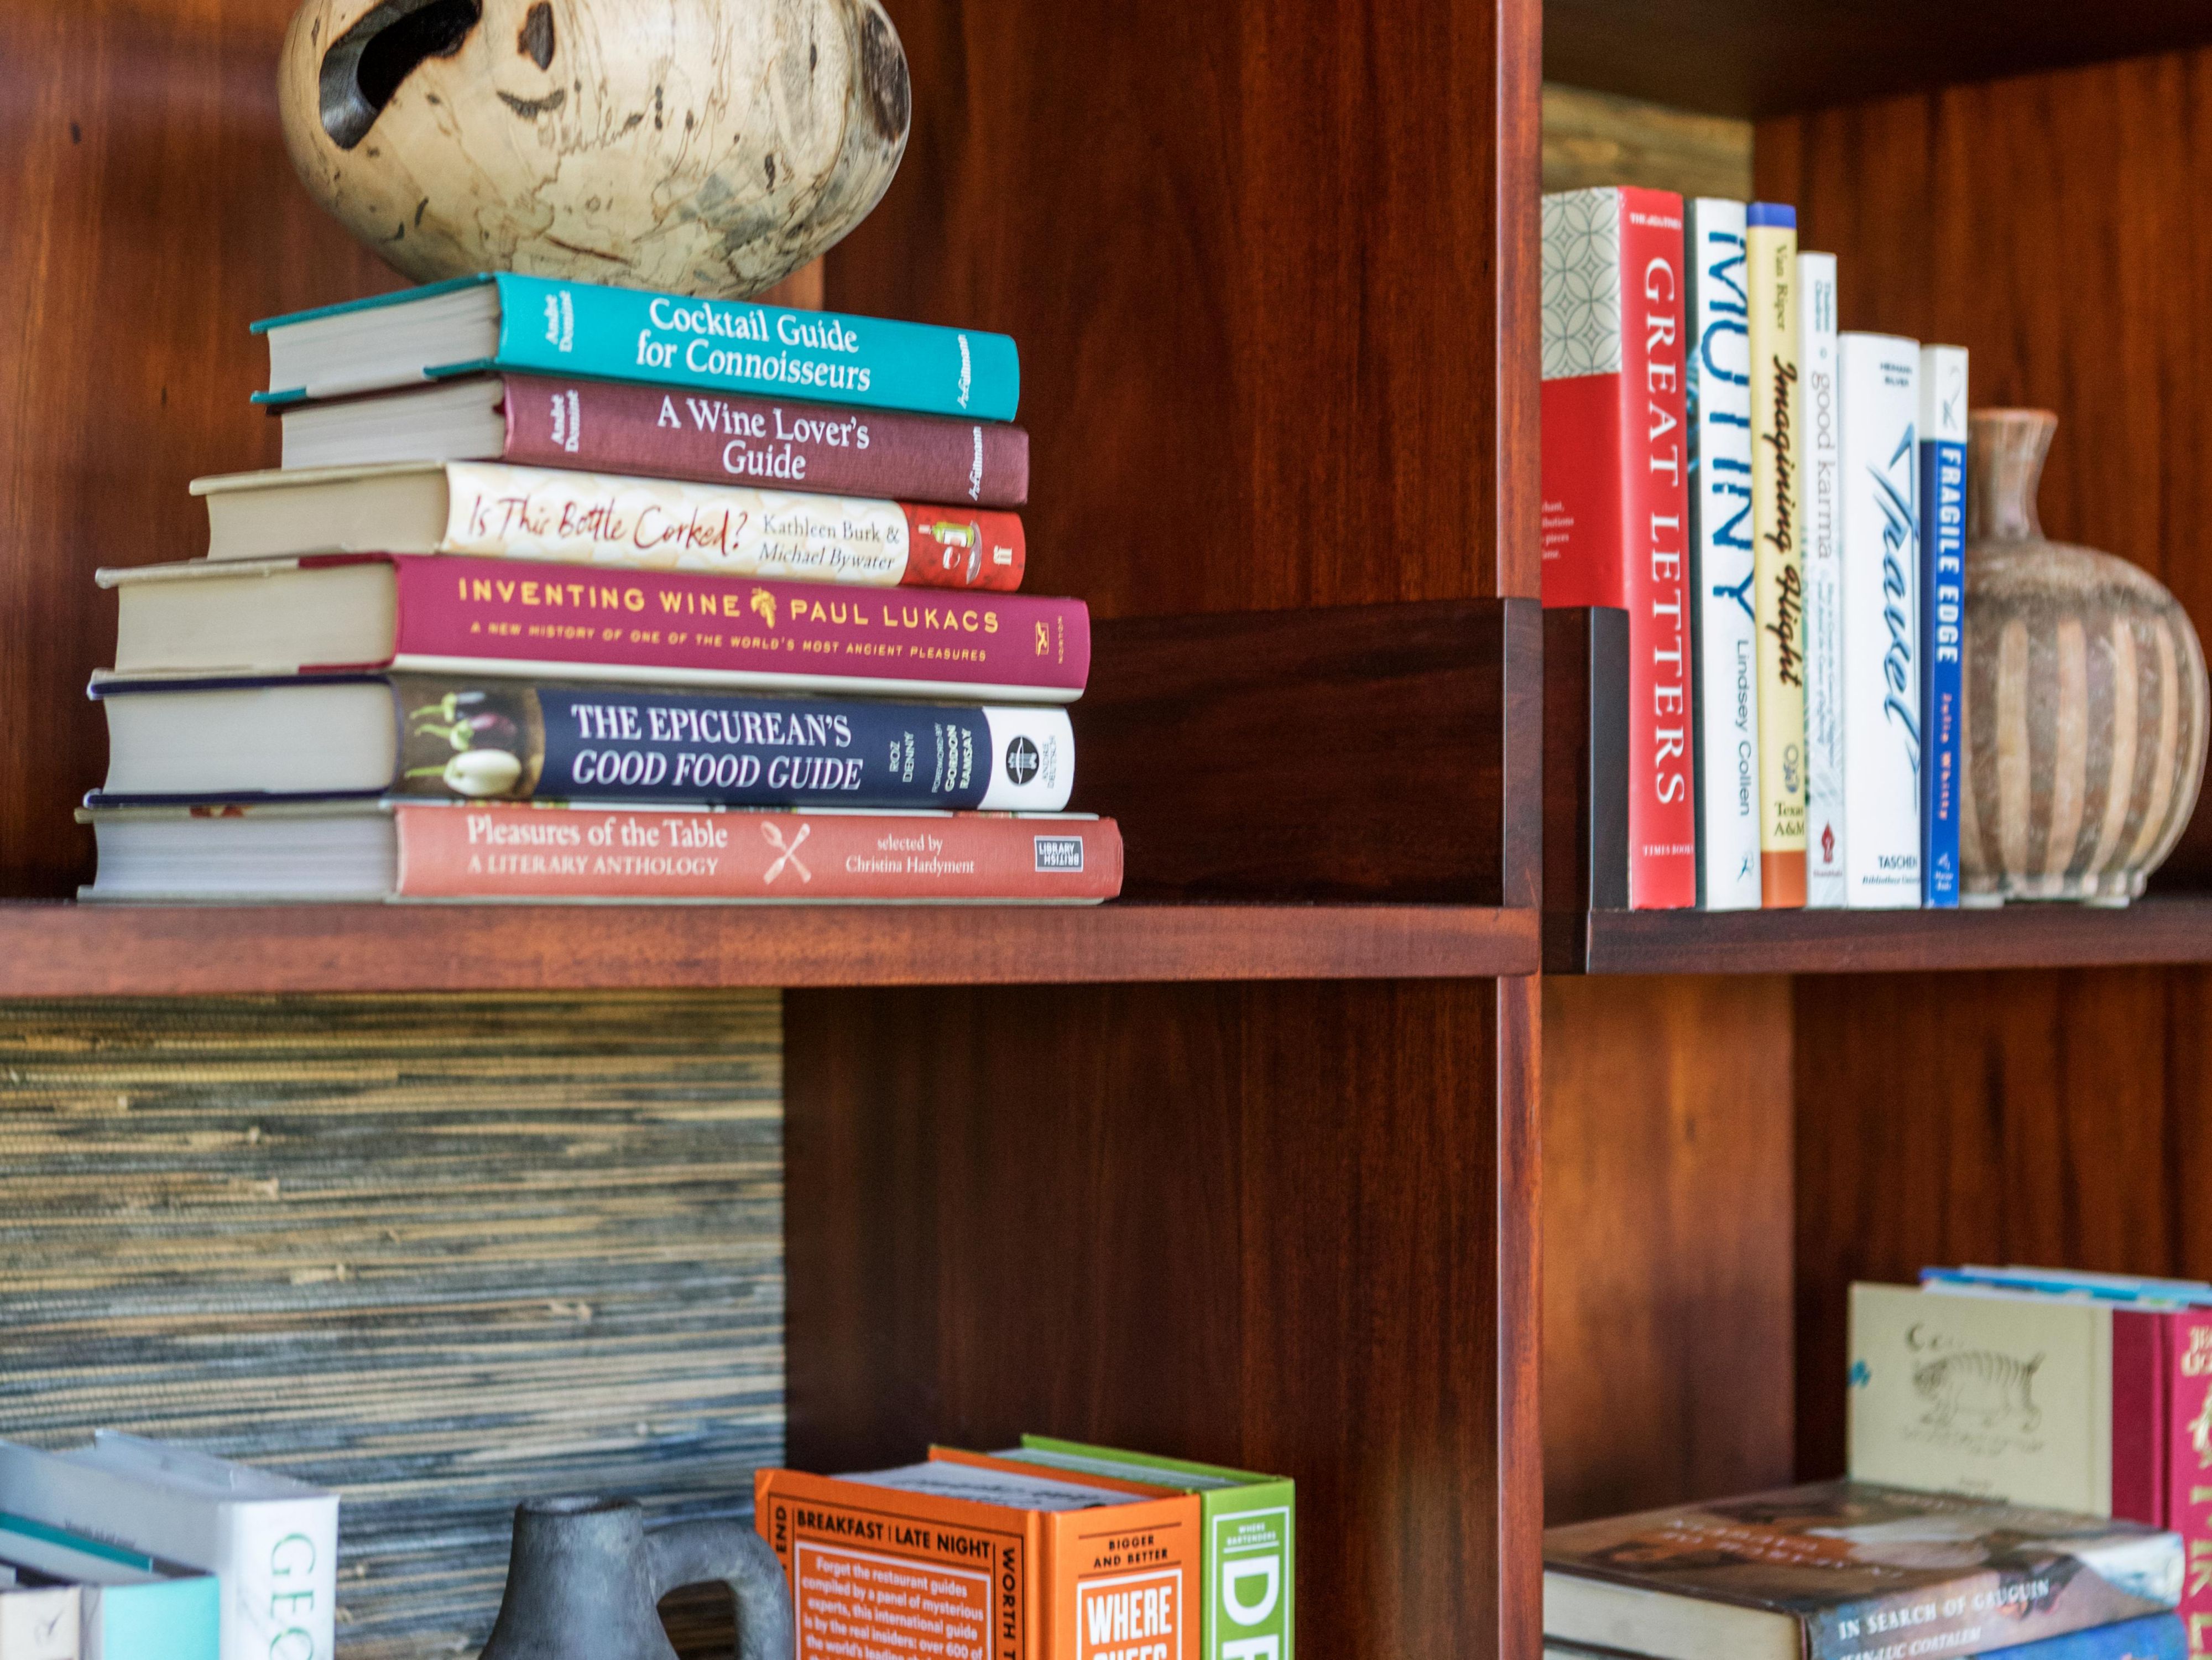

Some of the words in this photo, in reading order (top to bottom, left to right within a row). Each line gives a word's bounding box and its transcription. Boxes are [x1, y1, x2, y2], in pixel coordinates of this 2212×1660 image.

[649, 297, 770, 342] Cocktail
[776, 314, 859, 353] Guide
[636, 328, 678, 368] for
[686, 337, 871, 392] Connoisseurs
[1644, 257, 1679, 487] GREAT
[658, 394, 682, 429] A
[686, 398, 766, 438] Wine
[1701, 231, 1755, 624] MUTINY
[1812, 371, 1835, 450] good
[723, 439, 806, 480] Guide
[1762, 356, 1798, 553] Imagining
[468, 495, 490, 537] Is
[499, 494, 551, 540] This
[558, 497, 627, 542] Bottle
[633, 504, 748, 557] Corked?
[763, 515, 837, 538] Kathleen
[842, 520, 881, 543] Burk
[886, 525, 900, 544] &
[1818, 460, 1835, 560] karma
[1938, 447, 1961, 575] FRAGILE
[759, 543, 826, 566] Michael
[831, 550, 895, 574] Bywater
[458, 577, 645, 611] INVENTING
[659, 590, 741, 617] WINE
[790, 599, 869, 625] PAUL
[883, 604, 999, 633] LUKACS
[1766, 565, 1802, 688] Flight
[1866, 422, 1921, 780] Travel
[1937, 584, 1959, 665] EDGE
[470, 621, 481, 633] A
[488, 622, 521, 636] NEW
[528, 624, 596, 641] HISTORY
[602, 627, 623, 642] OF
[629, 629, 661, 644] ONE
[667, 632, 688, 646] OF
[695, 634, 723, 648] THE
[803, 638, 839, 654] MOST
[846, 641, 904, 658] ANCIENT
[910, 645, 987, 663] PLEASURES
[1650, 512, 1685, 805] LETTERS
[1735, 639, 1751, 732] Lindsey
[571, 704, 642, 741] THE
[571, 749, 667, 786] GOOD
[671, 752, 761, 788] FOOD
[768, 756, 864, 791] GUIDE
[889, 740, 900, 773] ROZ
[902, 730, 914, 783] DENNY
[945, 724, 958, 793] GORDON
[959, 727, 973, 789] RAMSAY
[1738, 741, 1752, 816] Collen
[467, 814, 581, 846] Pleasures
[587, 816, 617, 846] of
[620, 817, 660, 847] the
[662, 818, 728, 848] Table
[877, 834, 925, 852] selected
[928, 835, 943, 856] by
[1039, 842, 1075, 855] LIBRARY
[467, 854, 482, 873] A
[488, 854, 589, 875] LITERARY
[593, 856, 719, 876] ANTHOLOGY
[845, 855, 902, 873] Christina
[906, 856, 975, 877] Hardyment
[1044, 852, 1080, 866] BRITISH
[797, 1508, 884, 1542] BREAKFAST
[895, 1524, 931, 1549] LATE
[936, 1533, 990, 1559] NIGHT
[1109, 1534, 1154, 1550] BIGGER
[1238, 1522, 1265, 1533] WHERE
[816, 1555, 852, 1580] Forget
[853, 1563, 870, 1580] the
[873, 1569, 928, 1591] restaurant
[931, 1578, 968, 1598] guides
[1094, 1554, 1121, 1569] AND
[1128, 1548, 1168, 1564] BETTER
[802, 1576, 851, 1597] compiled
[853, 1584, 867, 1601] by
[868, 1591, 875, 1601] a
[877, 1591, 907, 1607] panel
[909, 1594, 922, 1609] of
[922, 1599, 984, 1621] mysterious
[808, 1597, 851, 1617] experts,
[852, 1604, 872, 1620] this
[874, 1609, 943, 1633] international
[945, 1623, 978, 1641] guide
[1003, 1547, 1016, 1640] WORTH
[1087, 1585, 1172, 1646] WHERE
[1839, 1619, 1860, 1640] IN
[1866, 1605, 1937, 1634] SEARCH
[1942, 1595, 1966, 1619] OF
[1974, 1578, 2050, 1610] GAUGUIN
[804, 1615, 813, 1628] is
[815, 1616, 828, 1633] by
[830, 1620, 848, 1635] the
[849, 1624, 869, 1639] real
[871, 1628, 917, 1649] insiders:
[919, 1638, 944, 1654] over
[946, 1641, 968, 1658] 600
[971, 1645, 983, 1660] of
[806, 1634, 824, 1650] the
